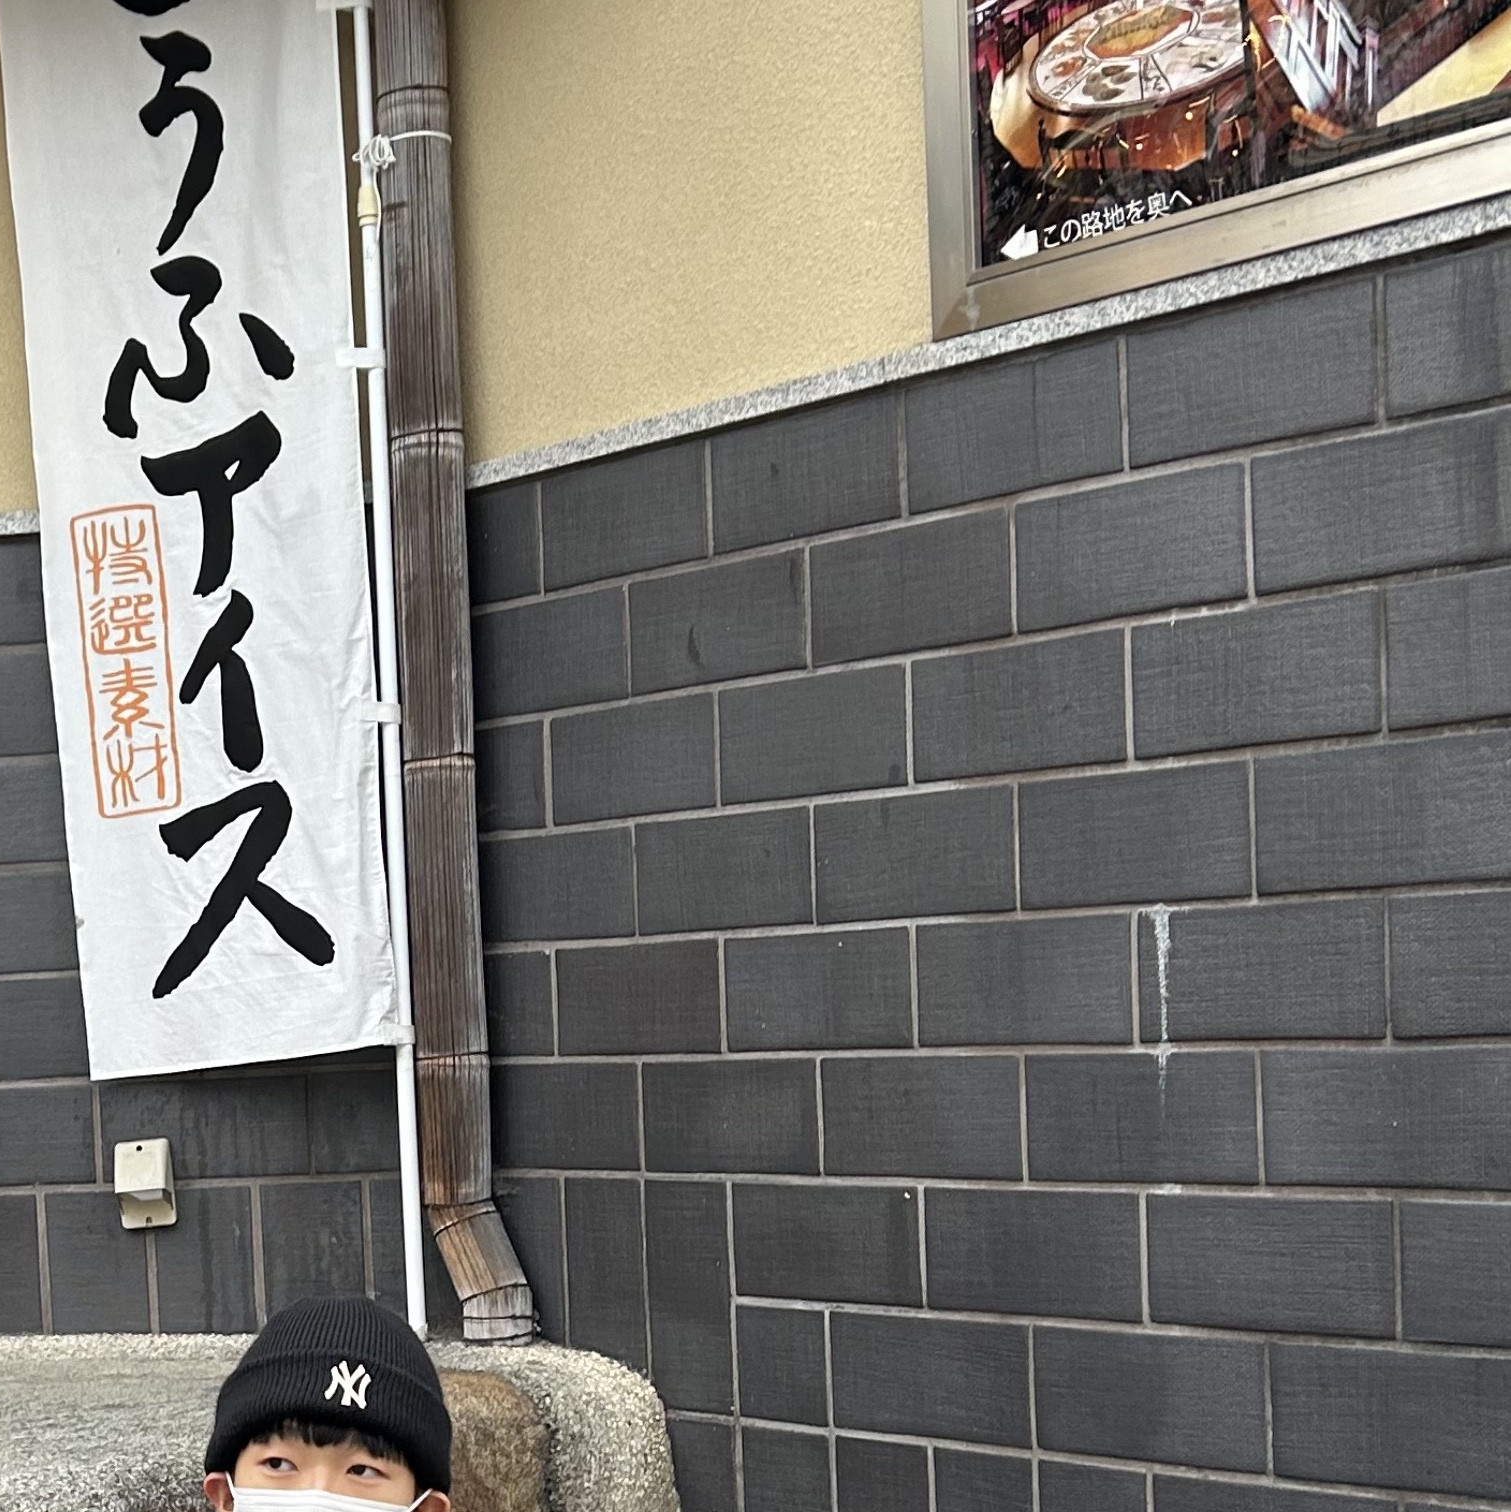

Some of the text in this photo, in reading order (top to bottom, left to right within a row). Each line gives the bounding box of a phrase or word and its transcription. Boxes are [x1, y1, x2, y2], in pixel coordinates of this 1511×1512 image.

[1043, 189, 1193, 249] この路地を奥へ
[101, 0, 336, 1000] うふアイス
[324, 1360, 372, 1410] NY
